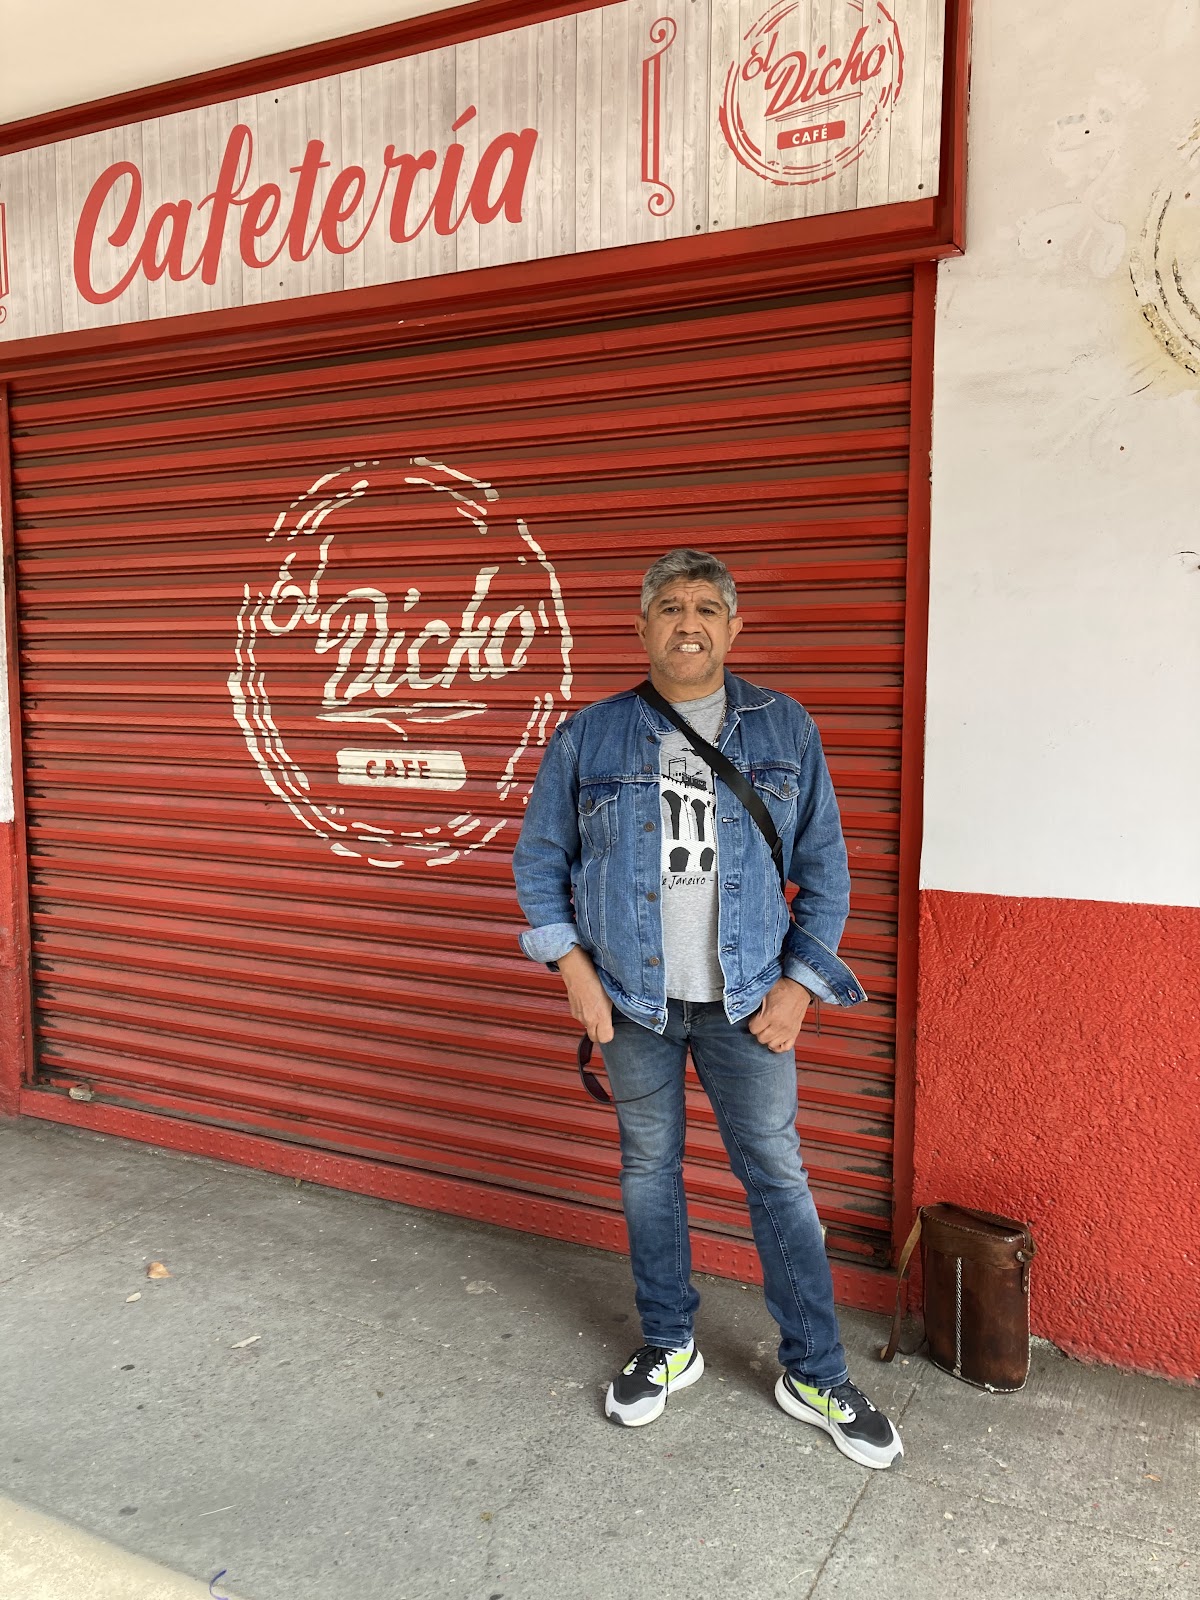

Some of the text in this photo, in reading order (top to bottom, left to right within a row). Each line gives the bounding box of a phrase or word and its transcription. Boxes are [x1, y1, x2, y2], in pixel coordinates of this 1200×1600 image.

[741, 25, 886, 117] El Dicho
[792, 125, 828, 145] CAFÉ
[73, 105, 538, 305] Cafetería
[261, 534, 536, 708] El Dicho
[365, 759, 431, 780] CAFE
[668, 874, 706, 890] Janeiro
